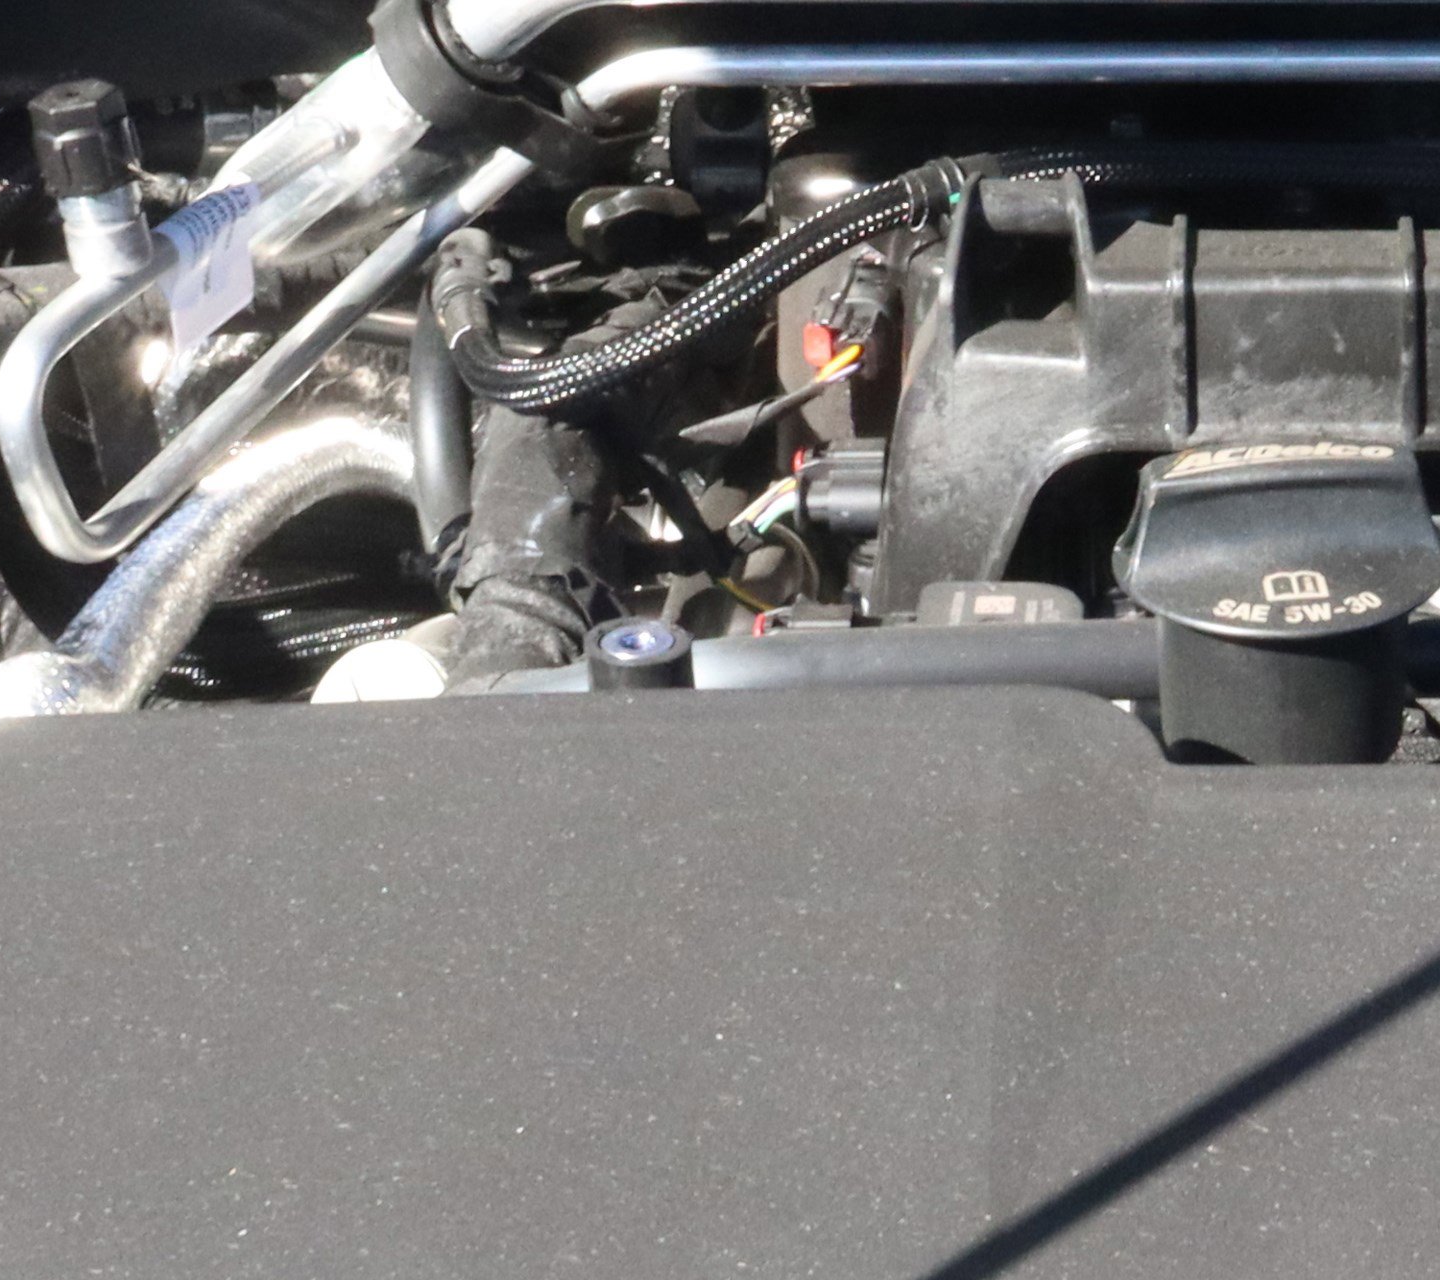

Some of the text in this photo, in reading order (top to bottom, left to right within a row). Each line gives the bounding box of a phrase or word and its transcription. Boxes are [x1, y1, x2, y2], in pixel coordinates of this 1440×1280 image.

[1163, 441, 1395, 479] ACDelco
[1213, 590, 1383, 625] SAE 5W-30
